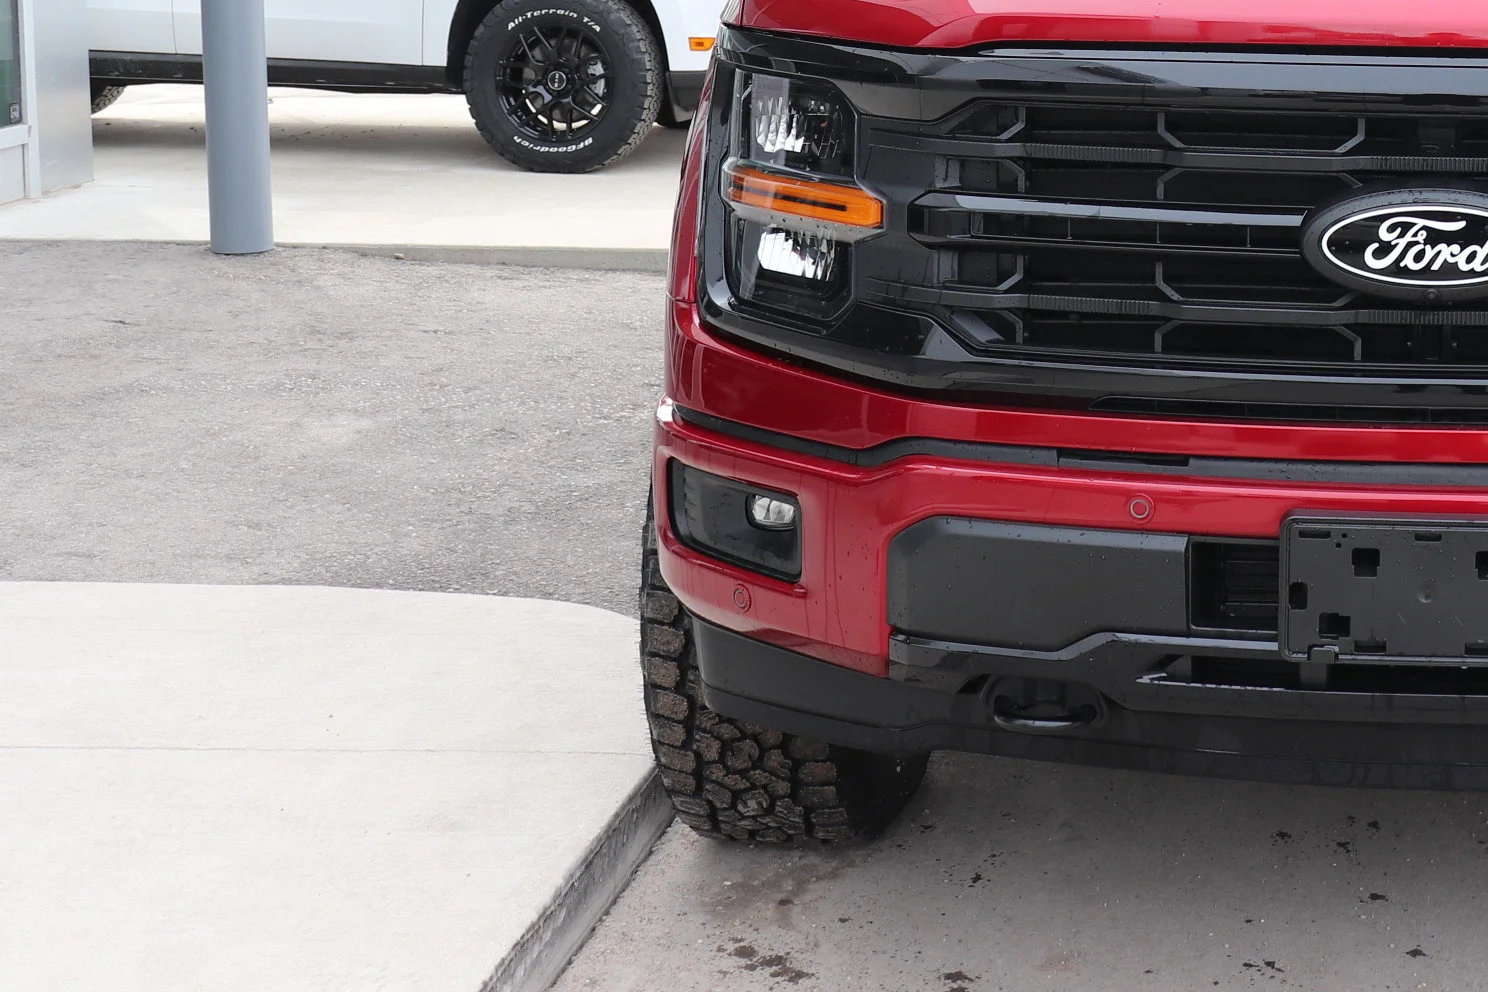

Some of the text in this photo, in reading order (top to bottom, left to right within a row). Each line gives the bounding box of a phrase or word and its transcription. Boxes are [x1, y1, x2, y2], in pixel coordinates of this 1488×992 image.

[507, 8, 601, 33] All-Terrain T/A
[513, 135, 593, 153] BFGoodrich
